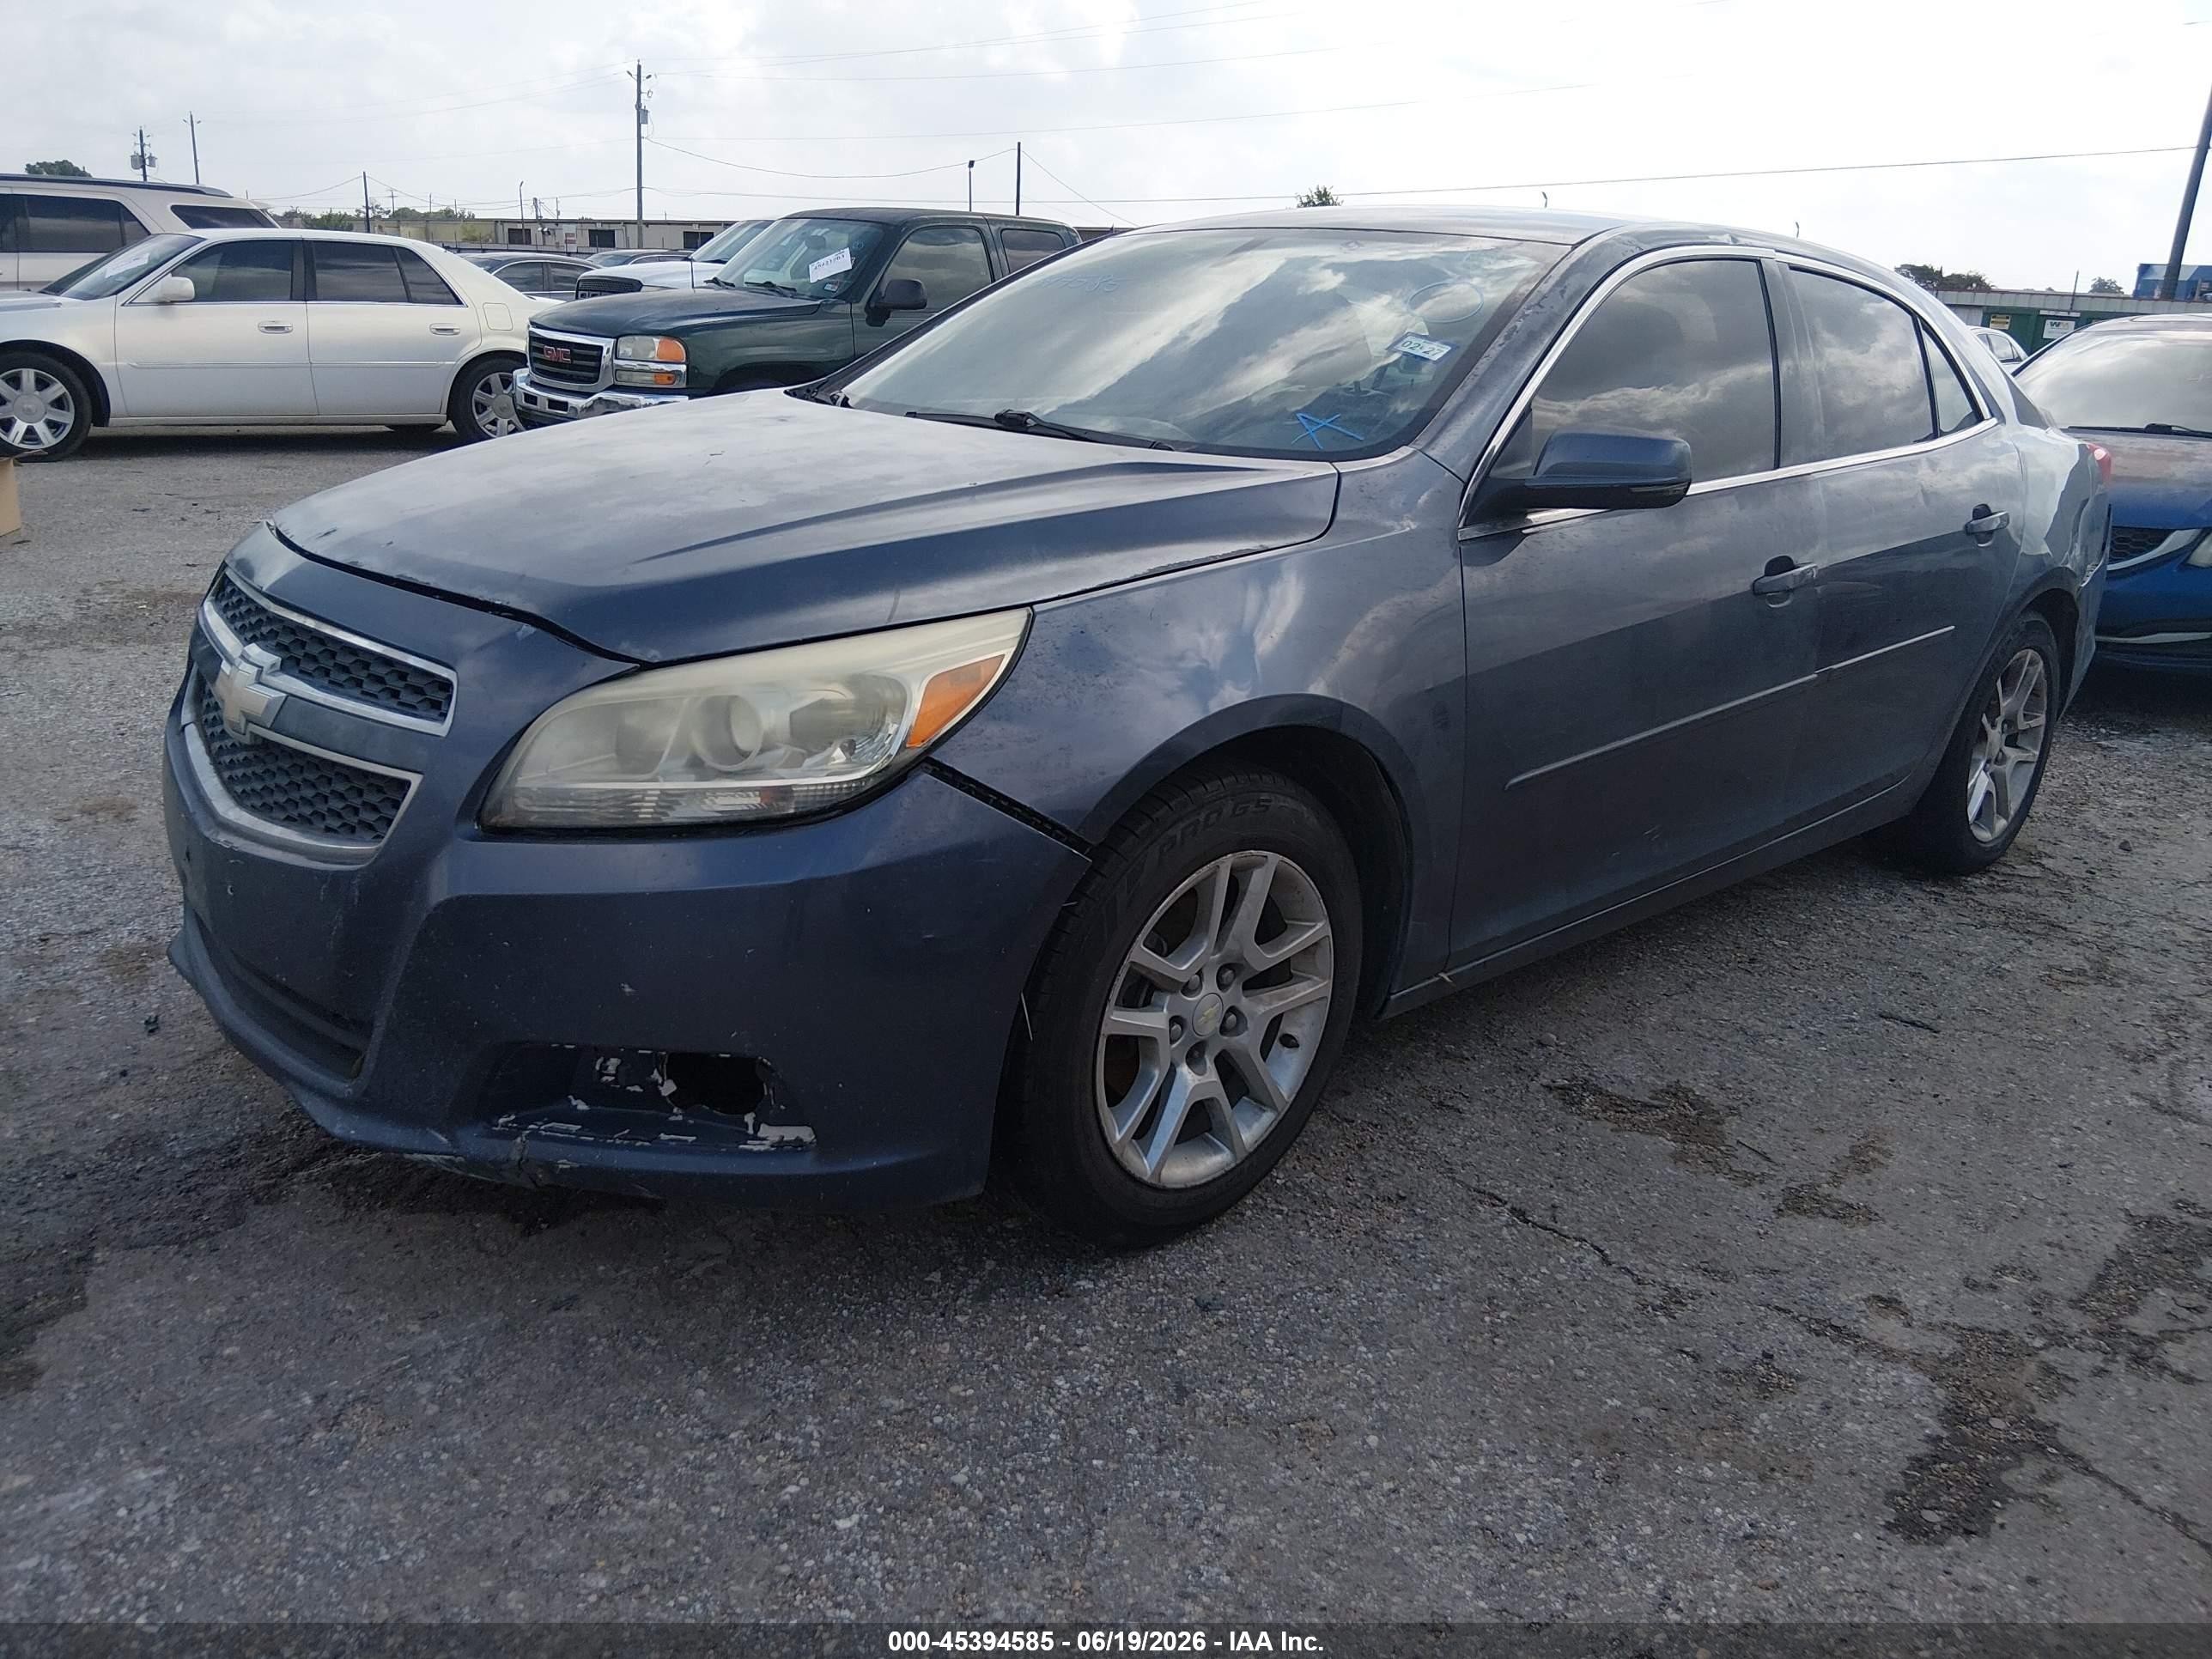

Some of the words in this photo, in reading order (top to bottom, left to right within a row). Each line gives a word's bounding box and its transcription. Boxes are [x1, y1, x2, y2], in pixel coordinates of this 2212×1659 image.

[543, 345, 571, 364] GMC
[1401, 340, 1421, 350] 02
[1422, 347, 1443, 356] 27
